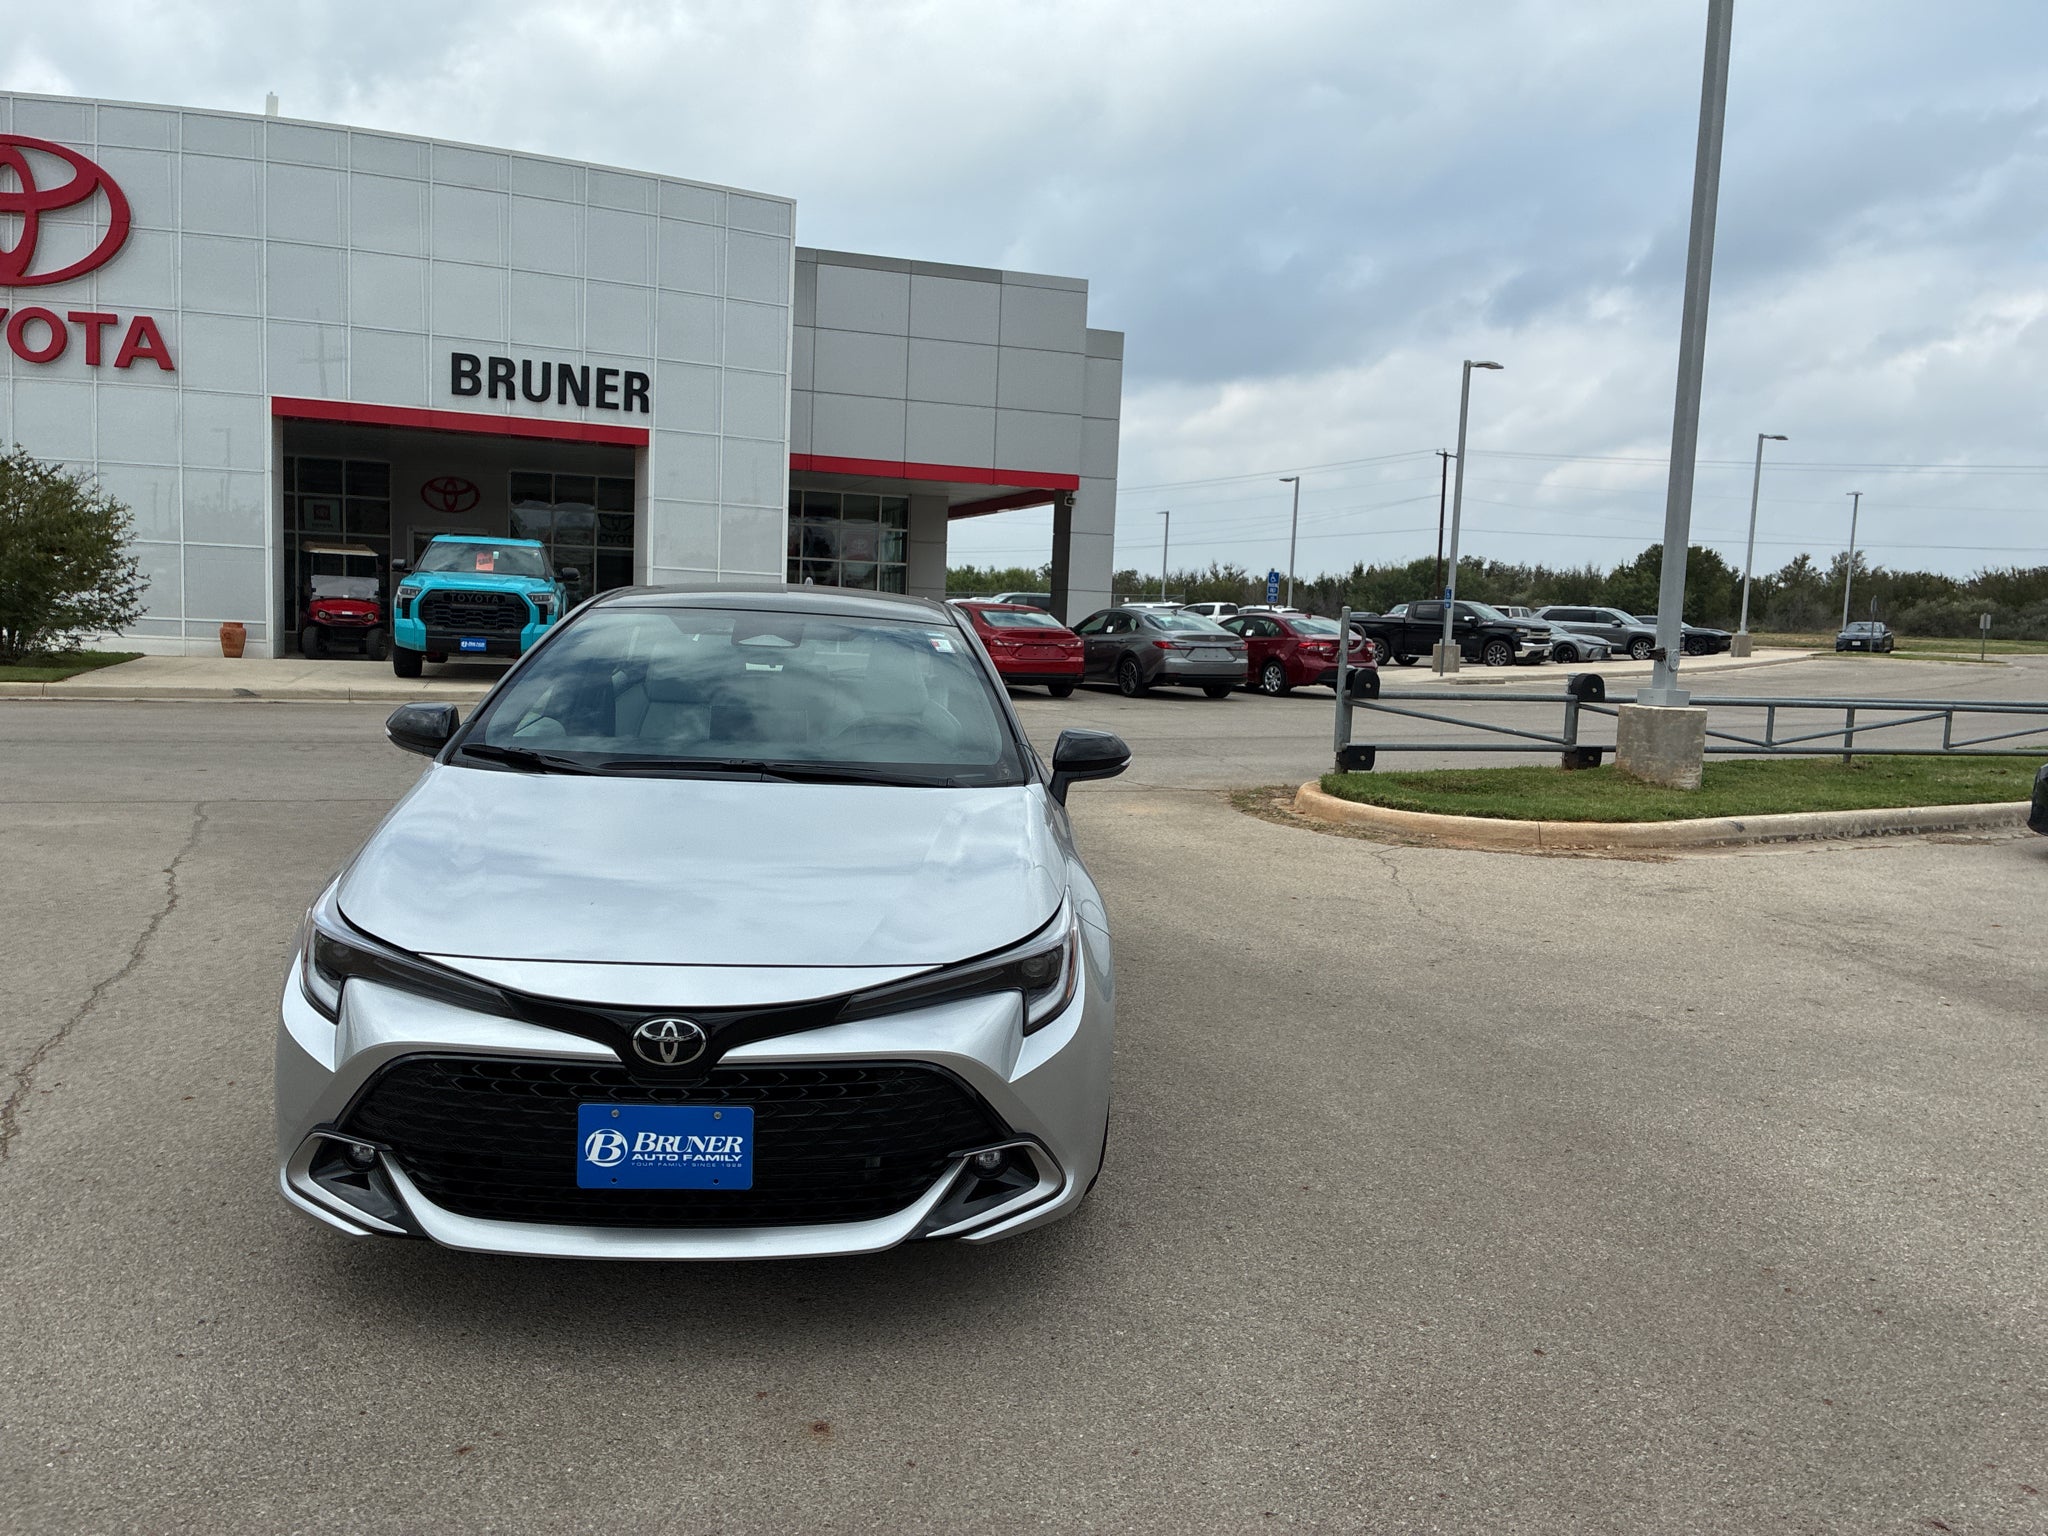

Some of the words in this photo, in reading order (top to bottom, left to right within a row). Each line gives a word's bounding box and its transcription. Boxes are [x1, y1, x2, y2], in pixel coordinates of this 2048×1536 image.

[0, 306, 175, 371] OTA
[451, 352, 650, 413] BRUNER
[451, 594, 499, 603] TOYOTA
[633, 1132, 743, 1153] BRUNER
[683, 1154, 743, 1162] FAMILY
